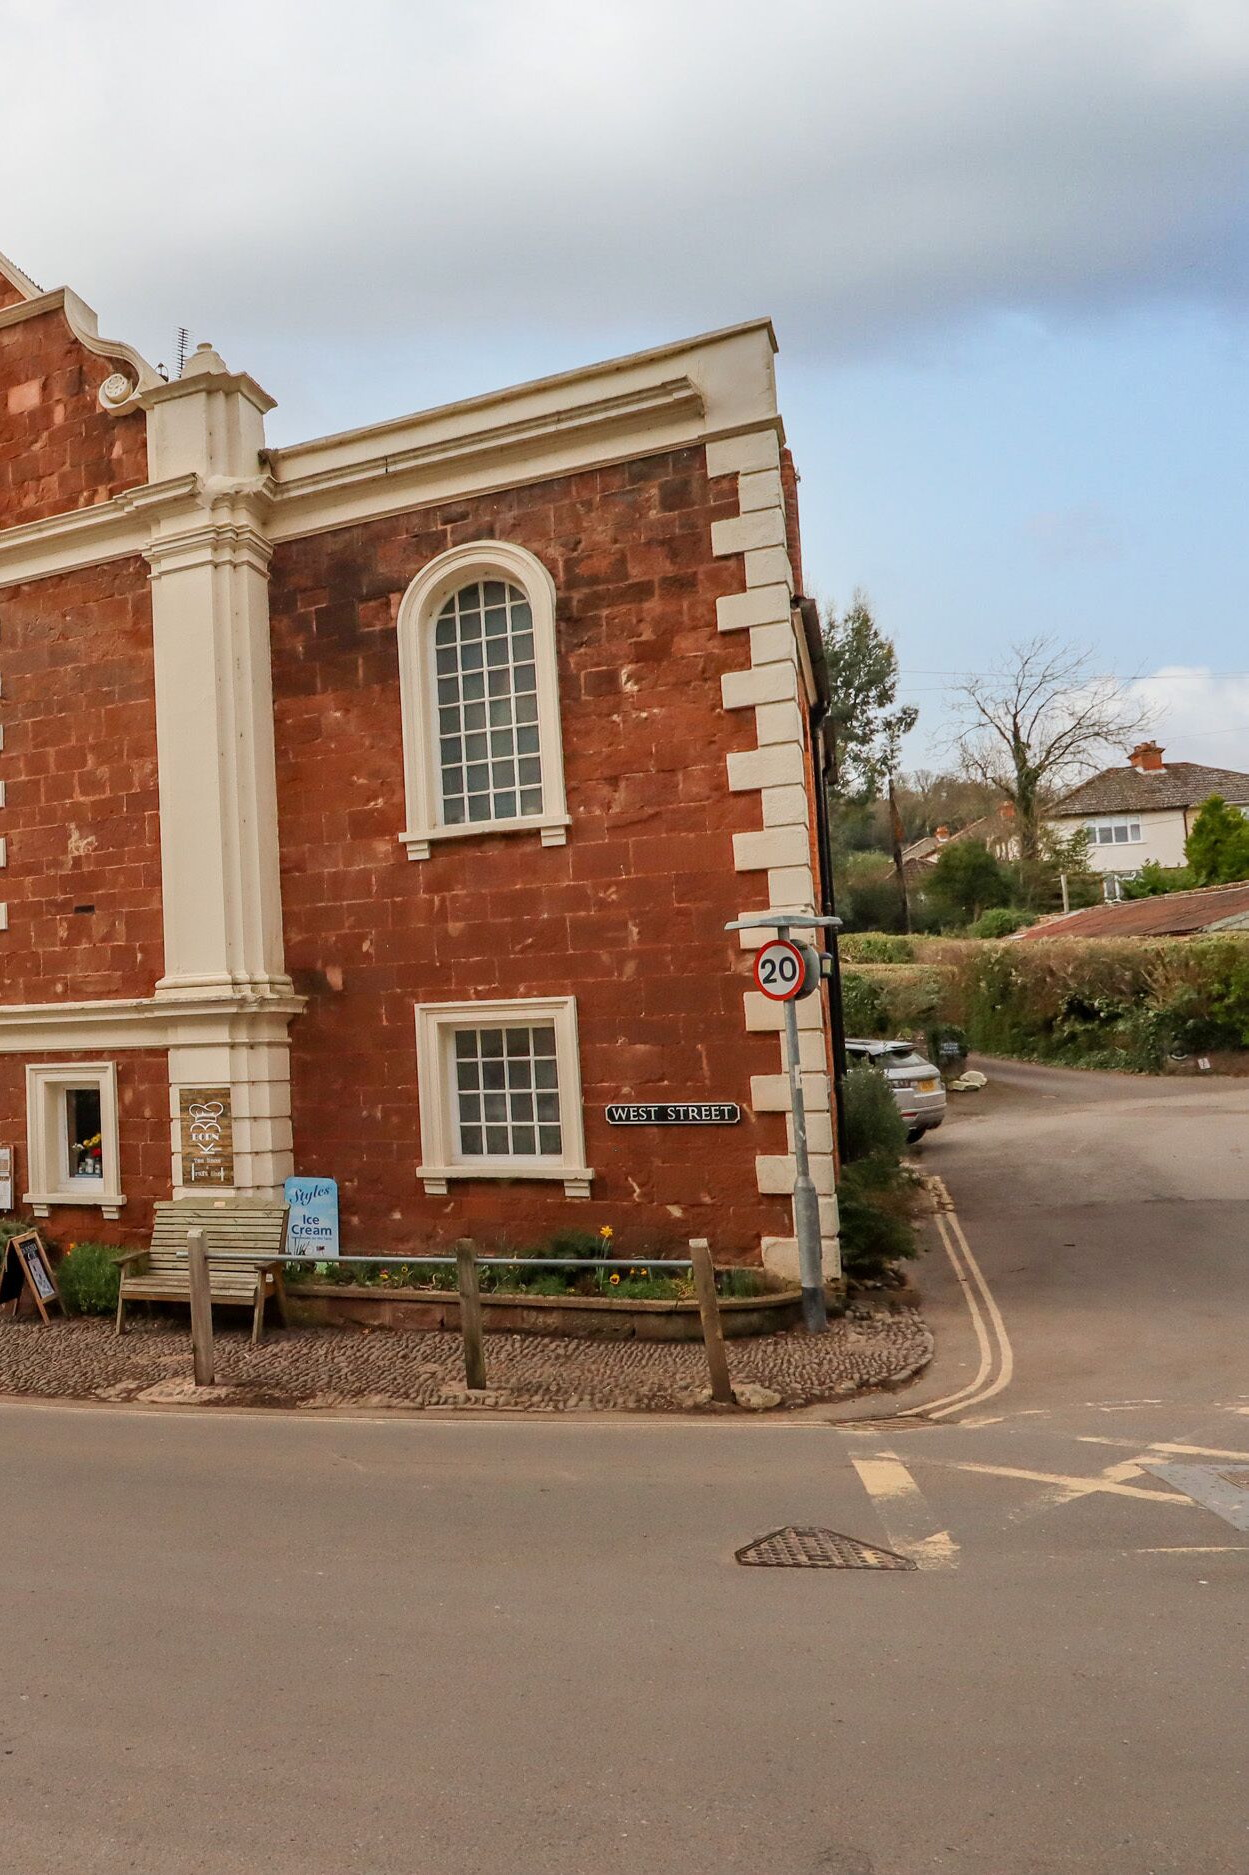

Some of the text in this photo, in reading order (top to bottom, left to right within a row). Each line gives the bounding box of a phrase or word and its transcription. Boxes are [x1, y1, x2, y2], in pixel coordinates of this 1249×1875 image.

[761, 956, 797, 985] 20
[611, 1106, 732, 1120] WEST STREET
[289, 1184, 330, 1206] Styles
[303, 1214, 320, 1225] Ice
[291, 1224, 332, 1236] Cream
